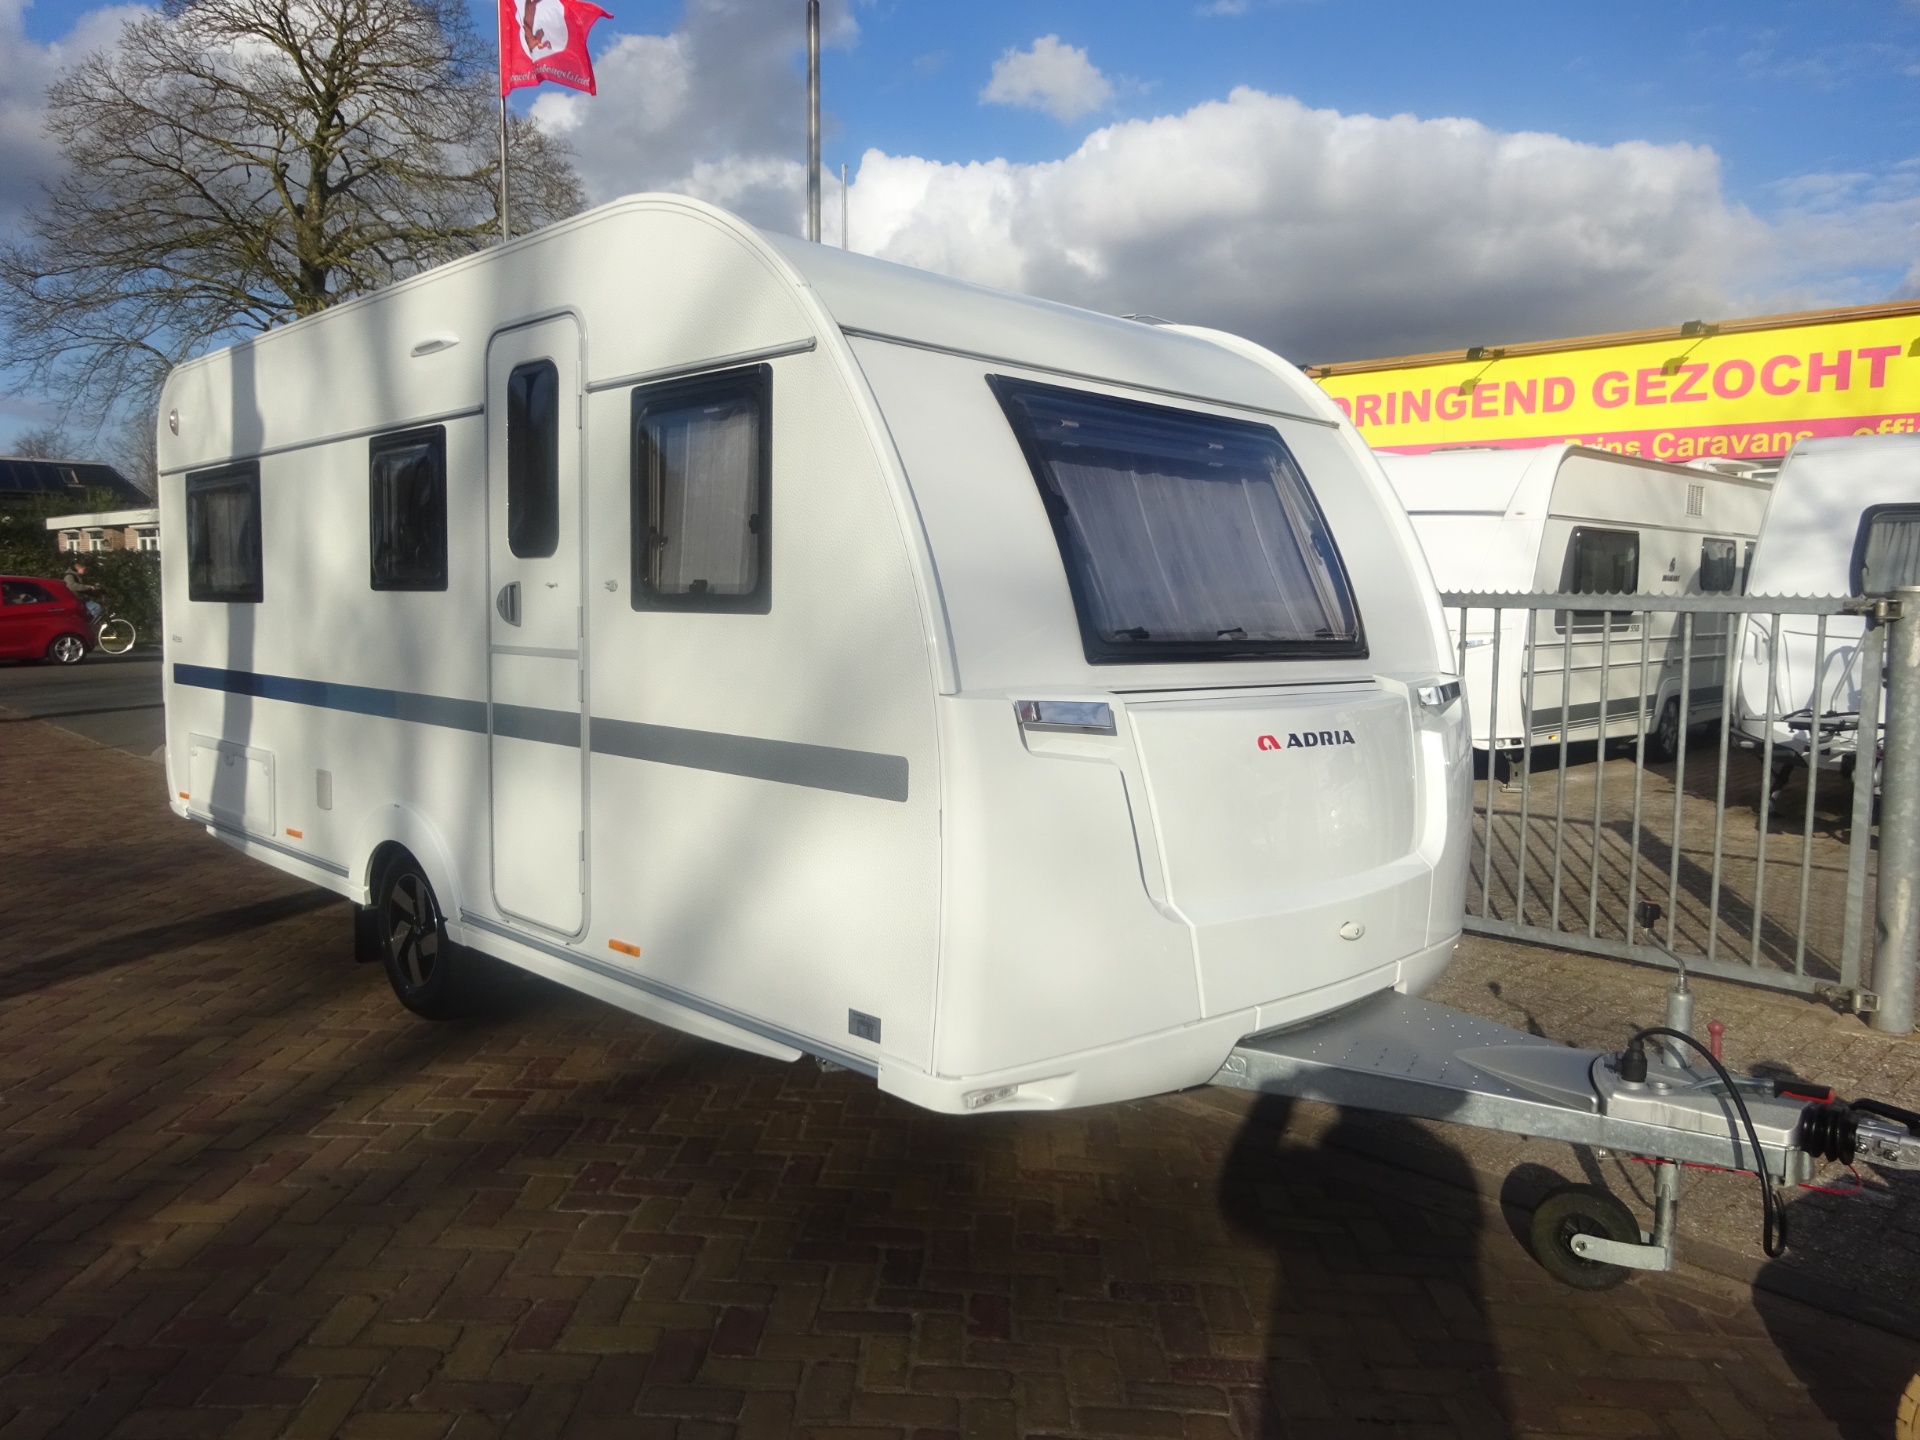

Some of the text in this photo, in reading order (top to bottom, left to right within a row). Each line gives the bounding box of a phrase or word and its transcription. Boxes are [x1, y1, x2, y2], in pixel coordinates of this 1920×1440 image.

[1592, 345, 1902, 409] GEZOCHT
[1564, 437, 1641, 456] ins
[1853, 417, 1920, 437] ffi
[1287, 730, 1356, 749] ADRIA
